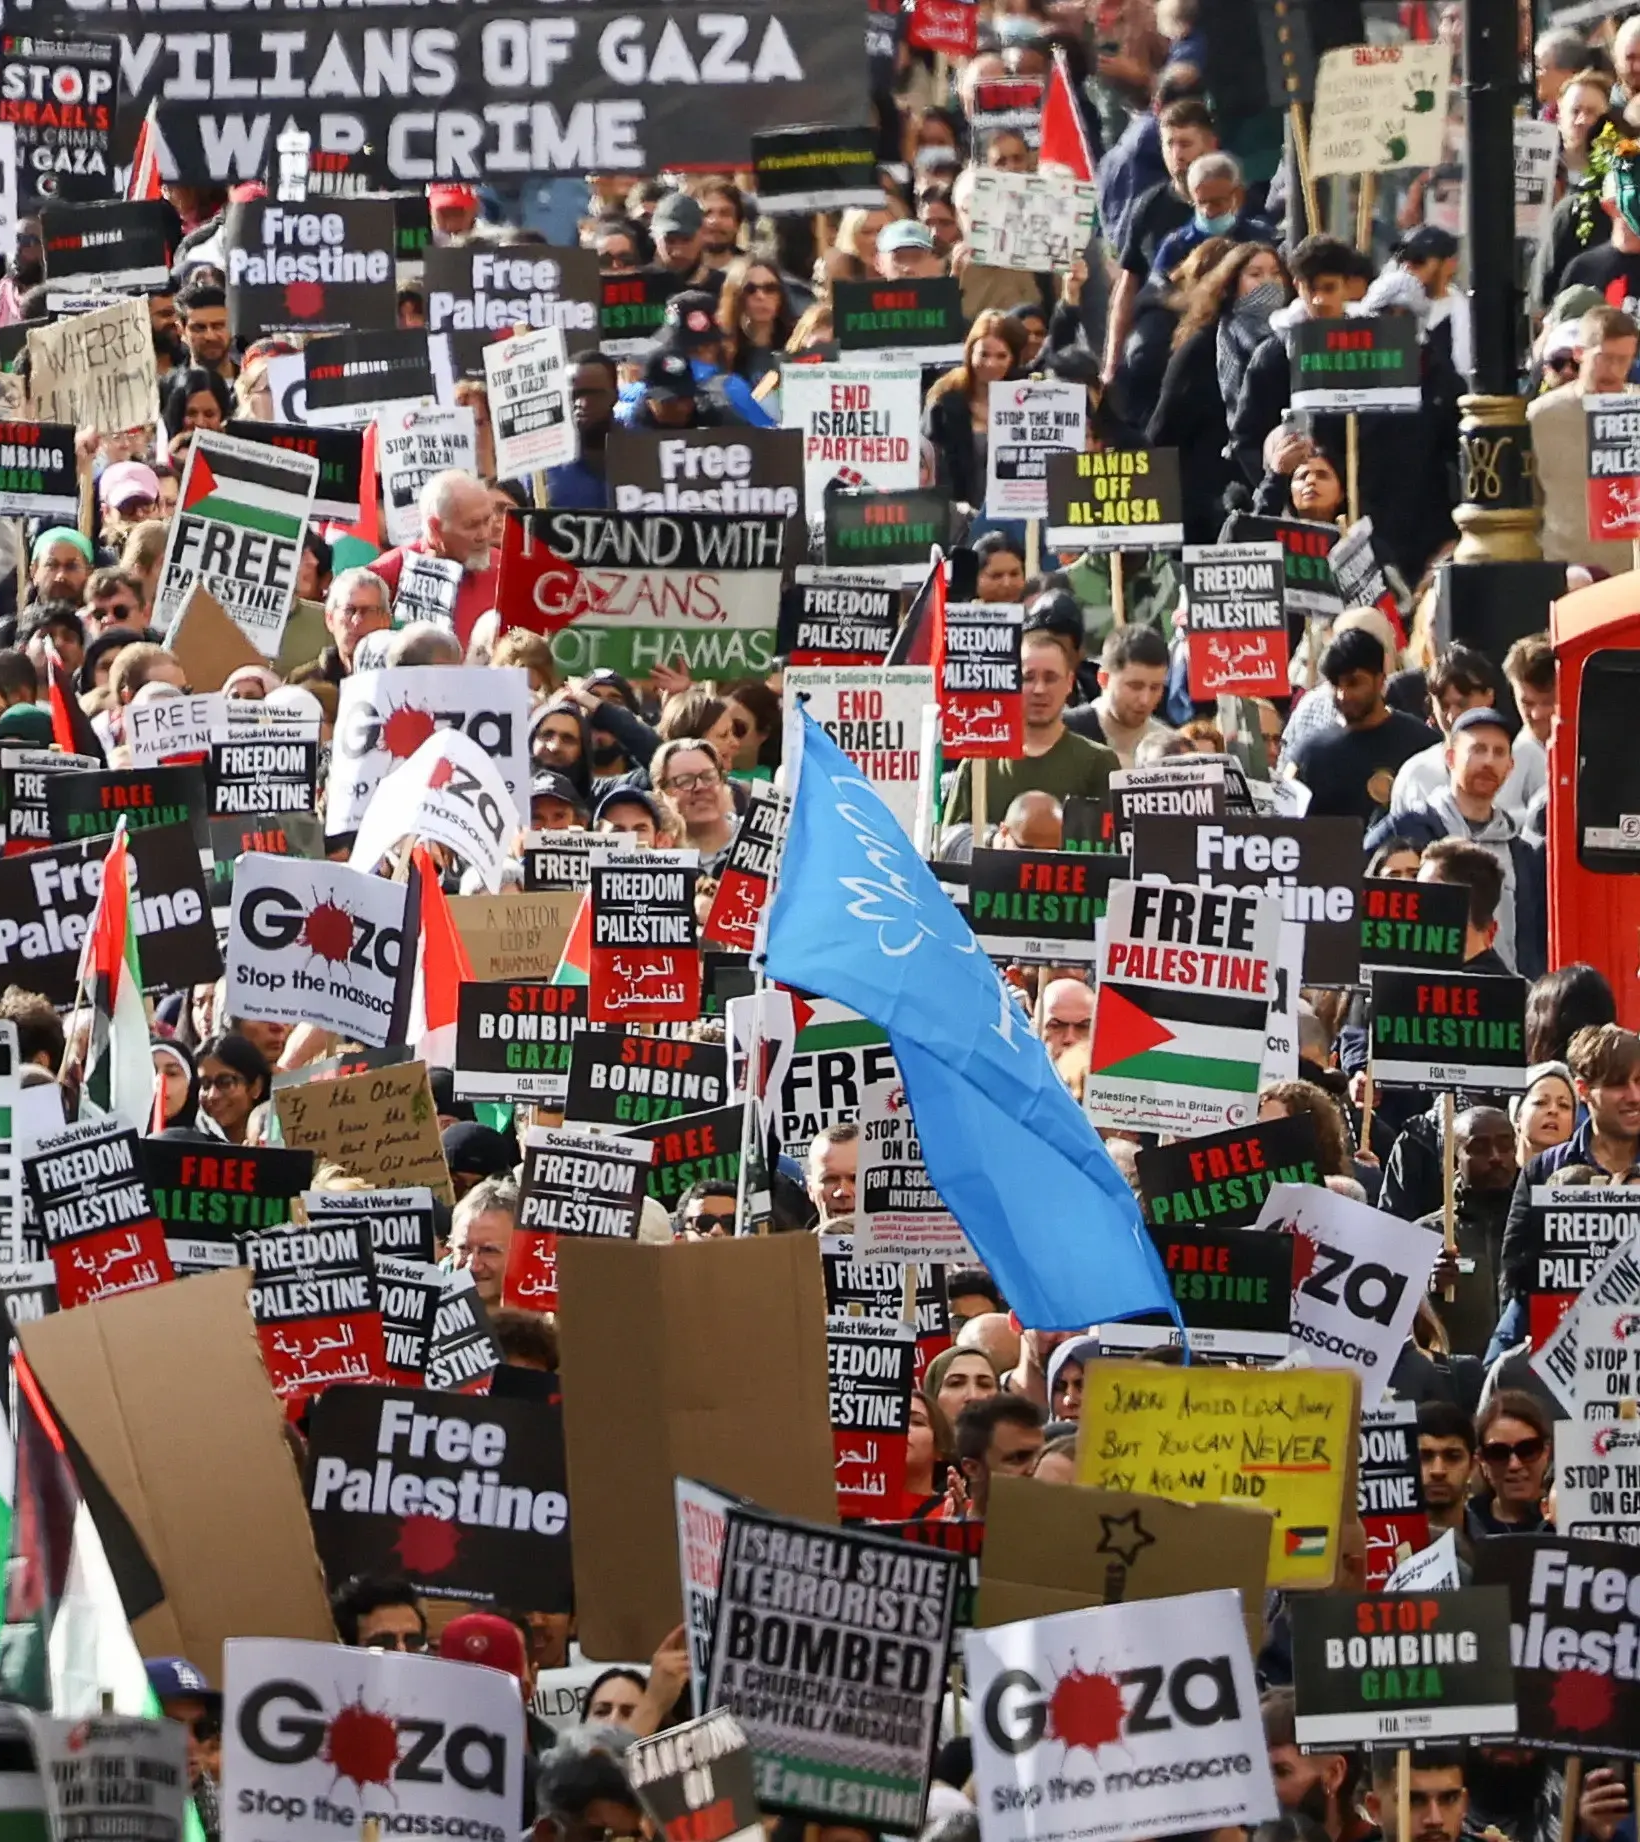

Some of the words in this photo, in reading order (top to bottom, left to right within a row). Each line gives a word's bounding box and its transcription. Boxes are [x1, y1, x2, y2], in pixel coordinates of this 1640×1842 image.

[118, 24, 459, 99] VILIANS
[481, 17, 580, 89] OF
[598, 13, 807, 85] GAZA
[2, 63, 112, 104] STOP
[387, 99, 647, 179] CRIME
[32, 148, 106, 175] GAZA
[263, 207, 344, 246] Free
[229, 242, 389, 285] Palestine
[473, 251, 559, 292] Free
[430, 290, 598, 332] Palestine
[44, 316, 147, 379] WHERE'S
[830, 384, 870, 410] END
[811, 410, 890, 438] ISRAELI
[994, 410, 1023, 426] STOP
[1027, 411, 1049, 426] THE
[1054, 410, 1080, 426] WAR
[659, 439, 752, 480] Free
[1076, 452, 1149, 476] HANDS
[1094, 476, 1131, 502] OFF
[1067, 499, 1160, 525] AL-AQSA
[170, 516, 297, 590] FREE
[521, 513, 535, 560] I
[550, 513, 681, 567] STAND
[692, 519, 784, 570] WITH
[1197, 547, 1236, 560] Socialist
[1237, 546, 1268, 559] Worker
[534, 568, 729, 623] GAZANS,
[1193, 563, 1275, 594] FREEDOM
[1191, 601, 1281, 628] PALESTINE
[632, 628, 774, 673] HAMAS
[1209, 637, 1268, 660] الحرية
[786, 673, 833, 686] Palestine
[837, 672, 880, 687] Solidarity
[885, 670, 933, 687] Campaign
[133, 701, 207, 738] FREE
[837, 690, 883, 721] END
[825, 721, 903, 751] ISRAELI
[605, 853, 647, 865] Socialist
[648, 853, 681, 866] Worker
[600, 870, 685, 900] FREEDOM
[505, 906, 559, 930] NATION
[596, 913, 691, 944] PALESTINE
[1129, 884, 1259, 952] FREE
[236, 964, 287, 991] Stop
[292, 969, 325, 992] the
[612, 954, 674, 982] الحرية
[1106, 942, 1270, 994] PALESTINE
[603, 984, 686, 1009] لفلسطين
[1417, 985, 1480, 1017] FREE
[620, 1037, 693, 1068] STOP
[1375, 1017, 1523, 1052] PALESTINE
[589, 1062, 720, 1103] BOMBING
[1427, 1065, 1447, 1080] FOA
[1091, 1089, 1137, 1104] Palestine
[1140, 1095, 1173, 1107] Forum
[1177, 1099, 1186, 1108] in
[1189, 1102, 1223, 1113] Britain
[865, 1118, 900, 1141] STOP
[36, 1138, 133, 1193] FREEDOM
[533, 1155, 635, 1195] FREEDOM
[867, 1169, 890, 1190] FOR
[892, 1170, 902, 1186] A
[42, 1188, 151, 1239] PALESTINE
[521, 1196, 634, 1238] PALESTINE
[375, 1399, 507, 1468] Free
[1242, 1429, 1331, 1464] NEVER
[311, 1456, 568, 1537] Palestine
[737, 1525, 851, 1579] ISRAELI
[857, 1551, 946, 1596] STATE
[730, 1562, 944, 1640] TERRORISTS
[1355, 1601, 1439, 1634] STOP
[728, 1609, 930, 1695] BOMBED
[1324, 1632, 1479, 1670] BOMBING
[1361, 1666, 1443, 1702] GAZA
[983, 1652, 1241, 1758] Gza
[236, 1678, 508, 1797] Gza
[1046, 1775, 1095, 1805] the
[1104, 1748, 1253, 1797] massacre
[236, 1787, 305, 1820] Stop
[312, 1795, 355, 1823] the
